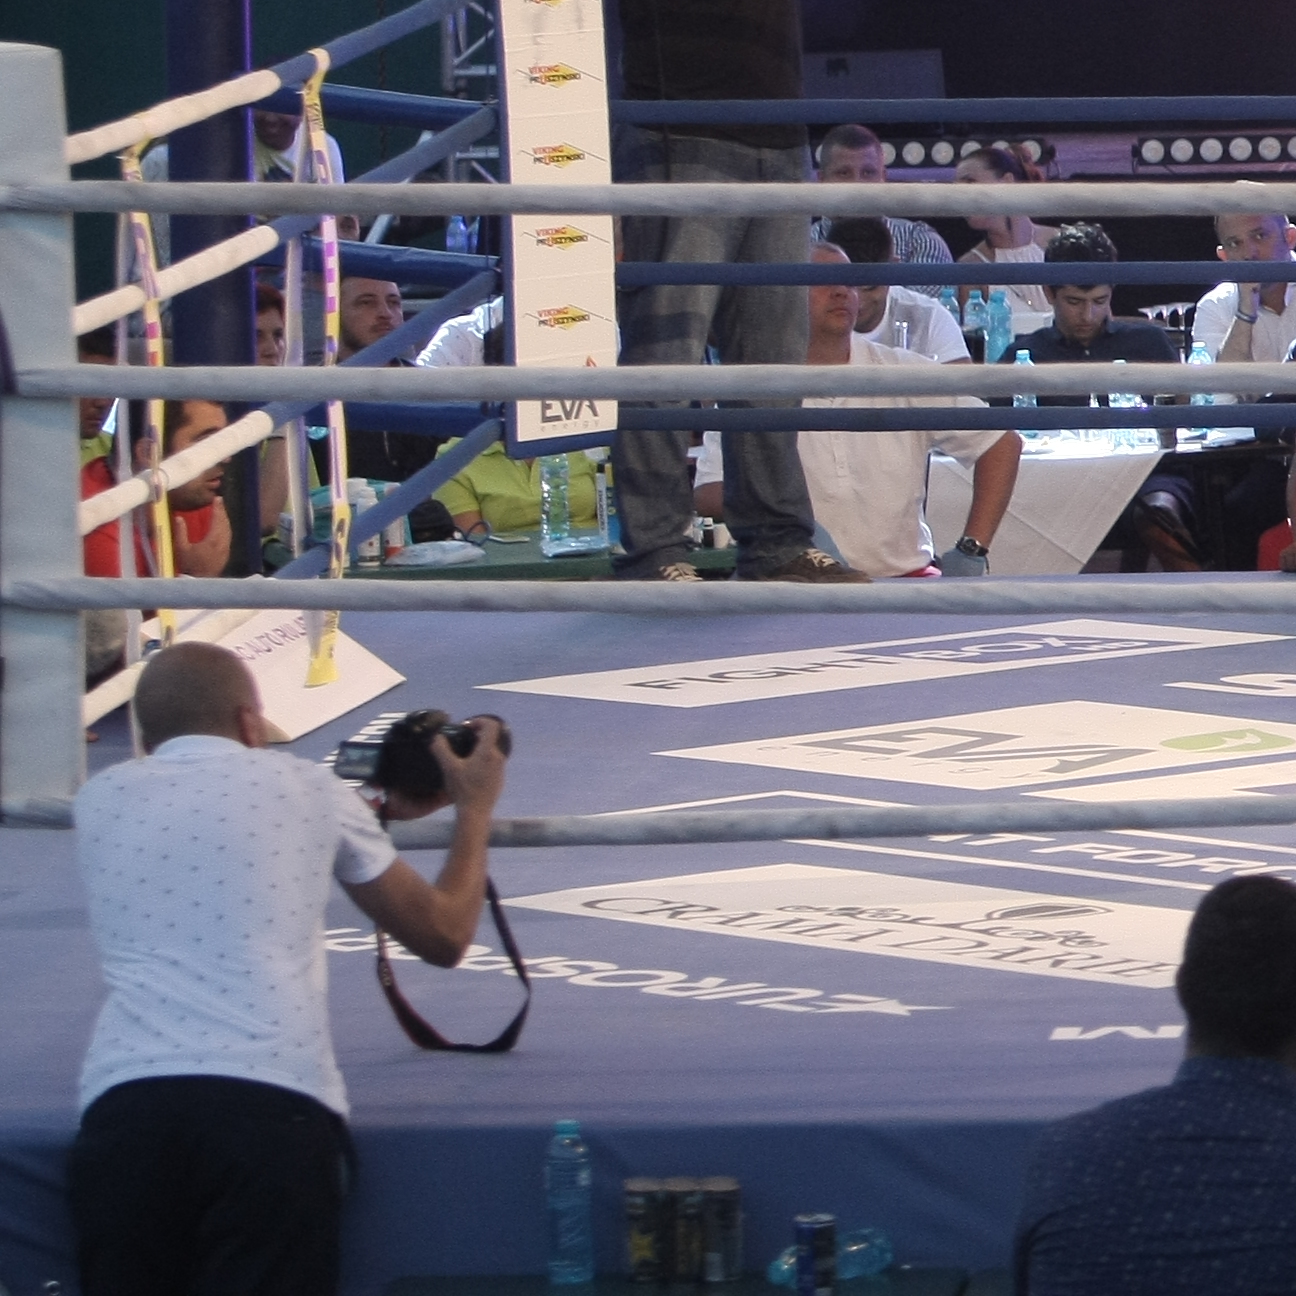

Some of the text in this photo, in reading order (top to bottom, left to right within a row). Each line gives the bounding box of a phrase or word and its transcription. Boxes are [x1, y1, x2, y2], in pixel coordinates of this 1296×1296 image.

[540, 400, 600, 424] EVA
[623, 656, 901, 691] FIGHT
[902, 636, 1098, 659] BOX
[581, 896, 899, 943] CRAMA
